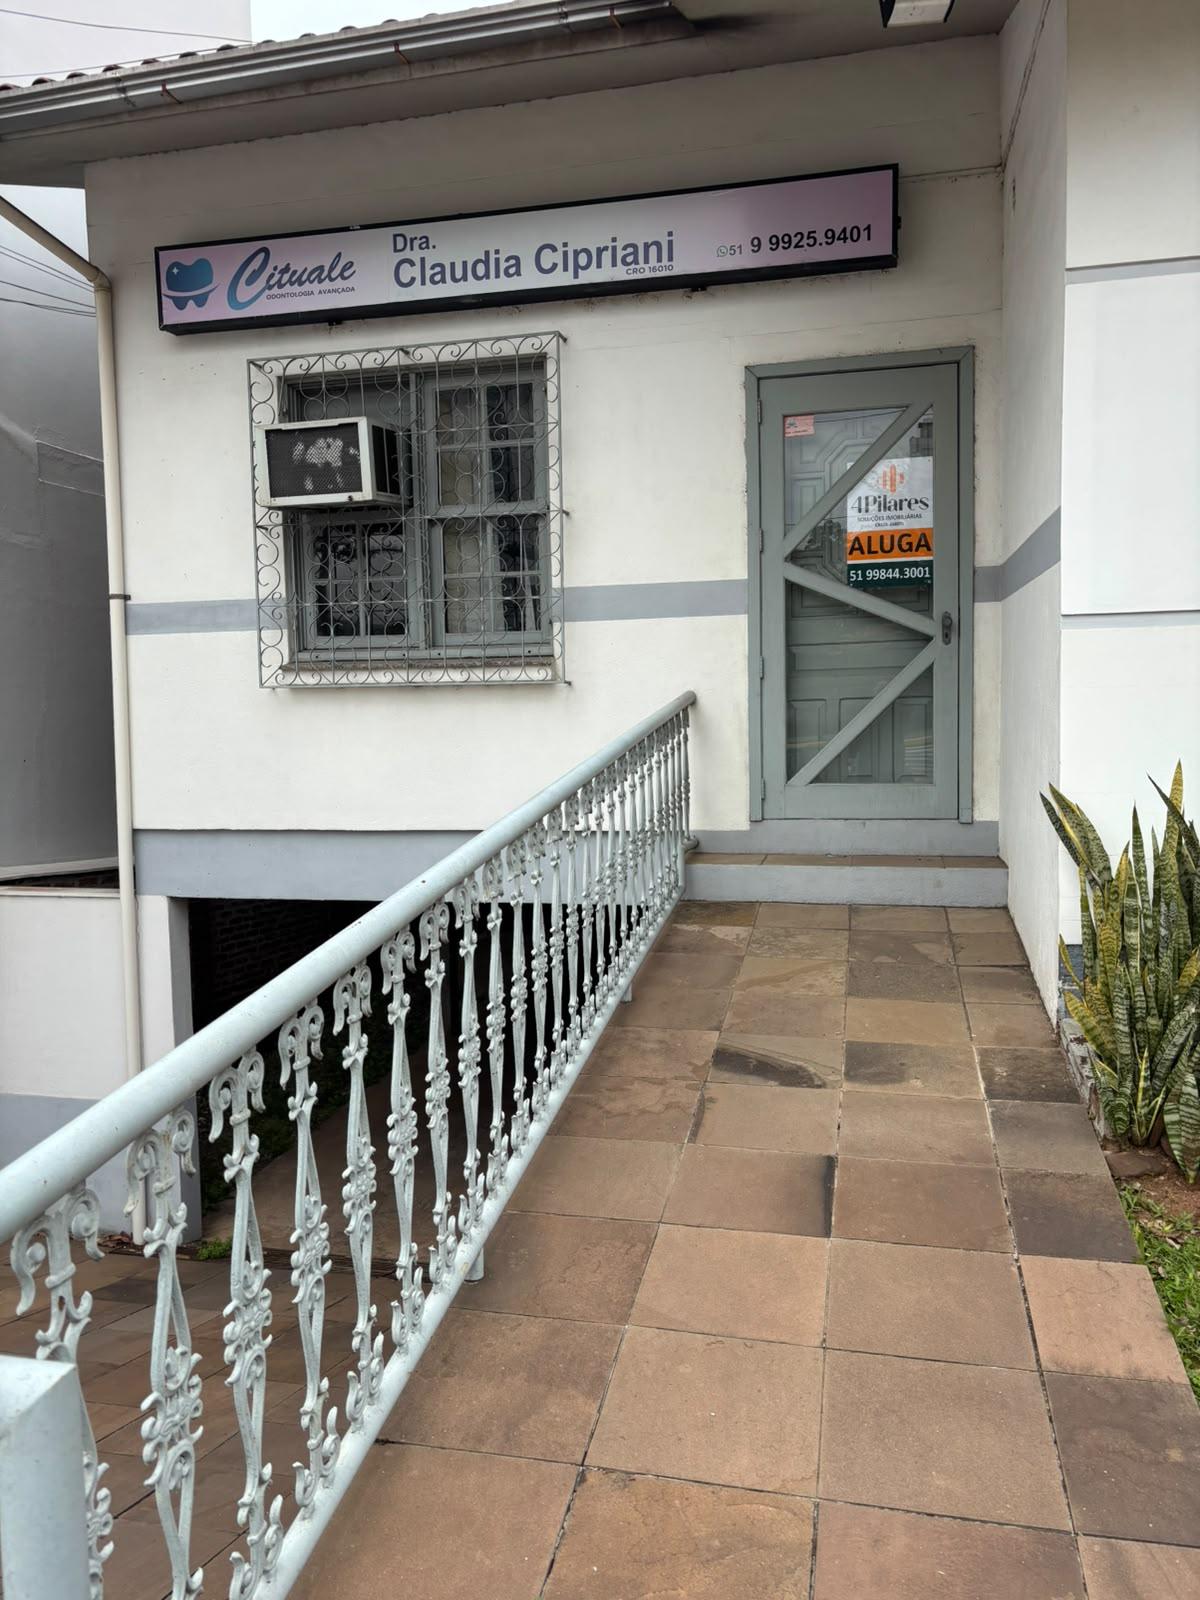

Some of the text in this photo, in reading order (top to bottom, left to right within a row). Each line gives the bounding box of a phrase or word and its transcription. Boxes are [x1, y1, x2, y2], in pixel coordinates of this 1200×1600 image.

[392, 233, 436, 253] Dra.
[729, 223, 872, 256] 51 9 9925.9401
[394, 231, 674, 288] Claudia Cipriani
[226, 246, 356, 311] Cituale
[626, 265, 645, 276] CRO
[266, 286, 355, 300] ODONTOLOGIA AVANÇADA
[851, 494, 930, 514] 4Pilares
[848, 532, 932, 556] ALUGA
[850, 566, 931, 581] 51 99844.3001
